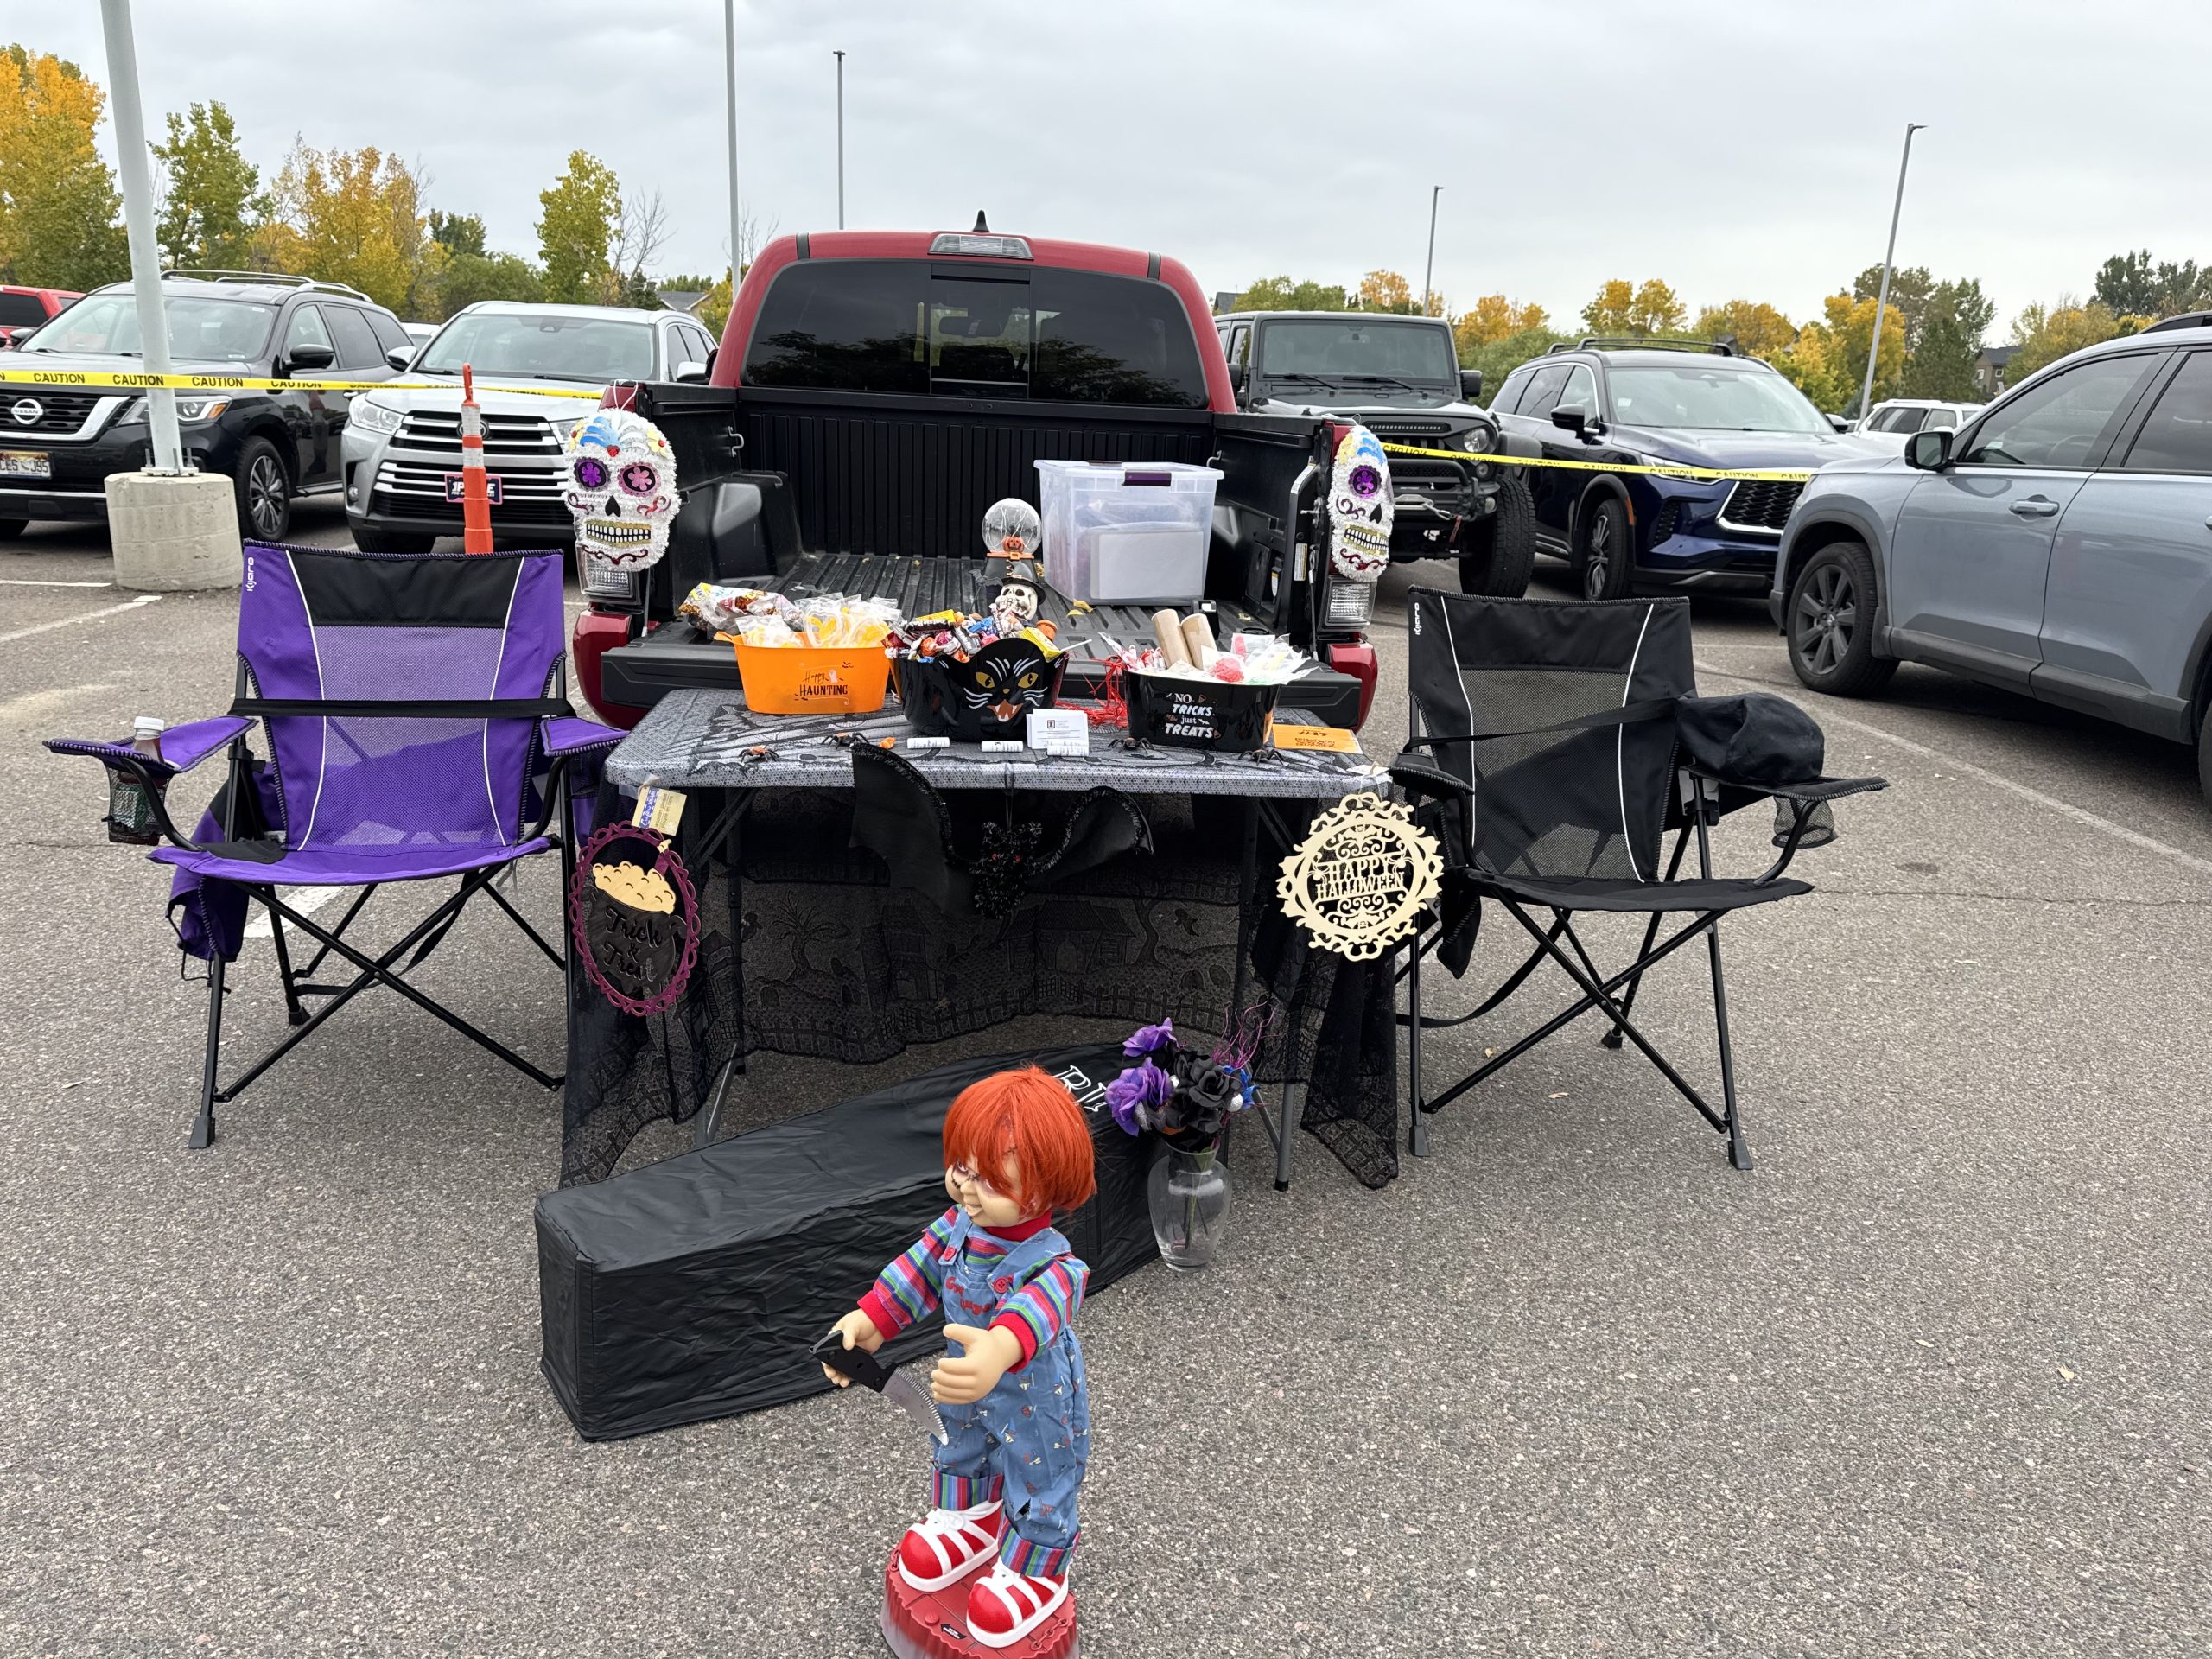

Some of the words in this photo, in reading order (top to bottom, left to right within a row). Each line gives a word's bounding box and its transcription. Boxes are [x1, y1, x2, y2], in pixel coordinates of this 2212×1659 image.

[34, 373, 85, 384] CAUTION
[113, 374, 164, 385] CAUTION
[192, 377, 243, 387] CAUTION
[245, 556, 257, 592] Kijaro
[803, 671, 827, 684] Happy
[799, 684, 848, 696] HAUNTING
[1175, 693, 1192, 703] NO
[1173, 703, 1213, 716] TRICKS
[1180, 715, 1197, 724] just
[1165, 723, 1214, 738] TREATS
[1328, 856, 1389, 881] HAPPY
[1315, 872, 1405, 899] HALLOWEEN
[605, 905, 663, 948] Trick
[627, 943, 640, 963] &
[602, 941, 657, 982] Treat
